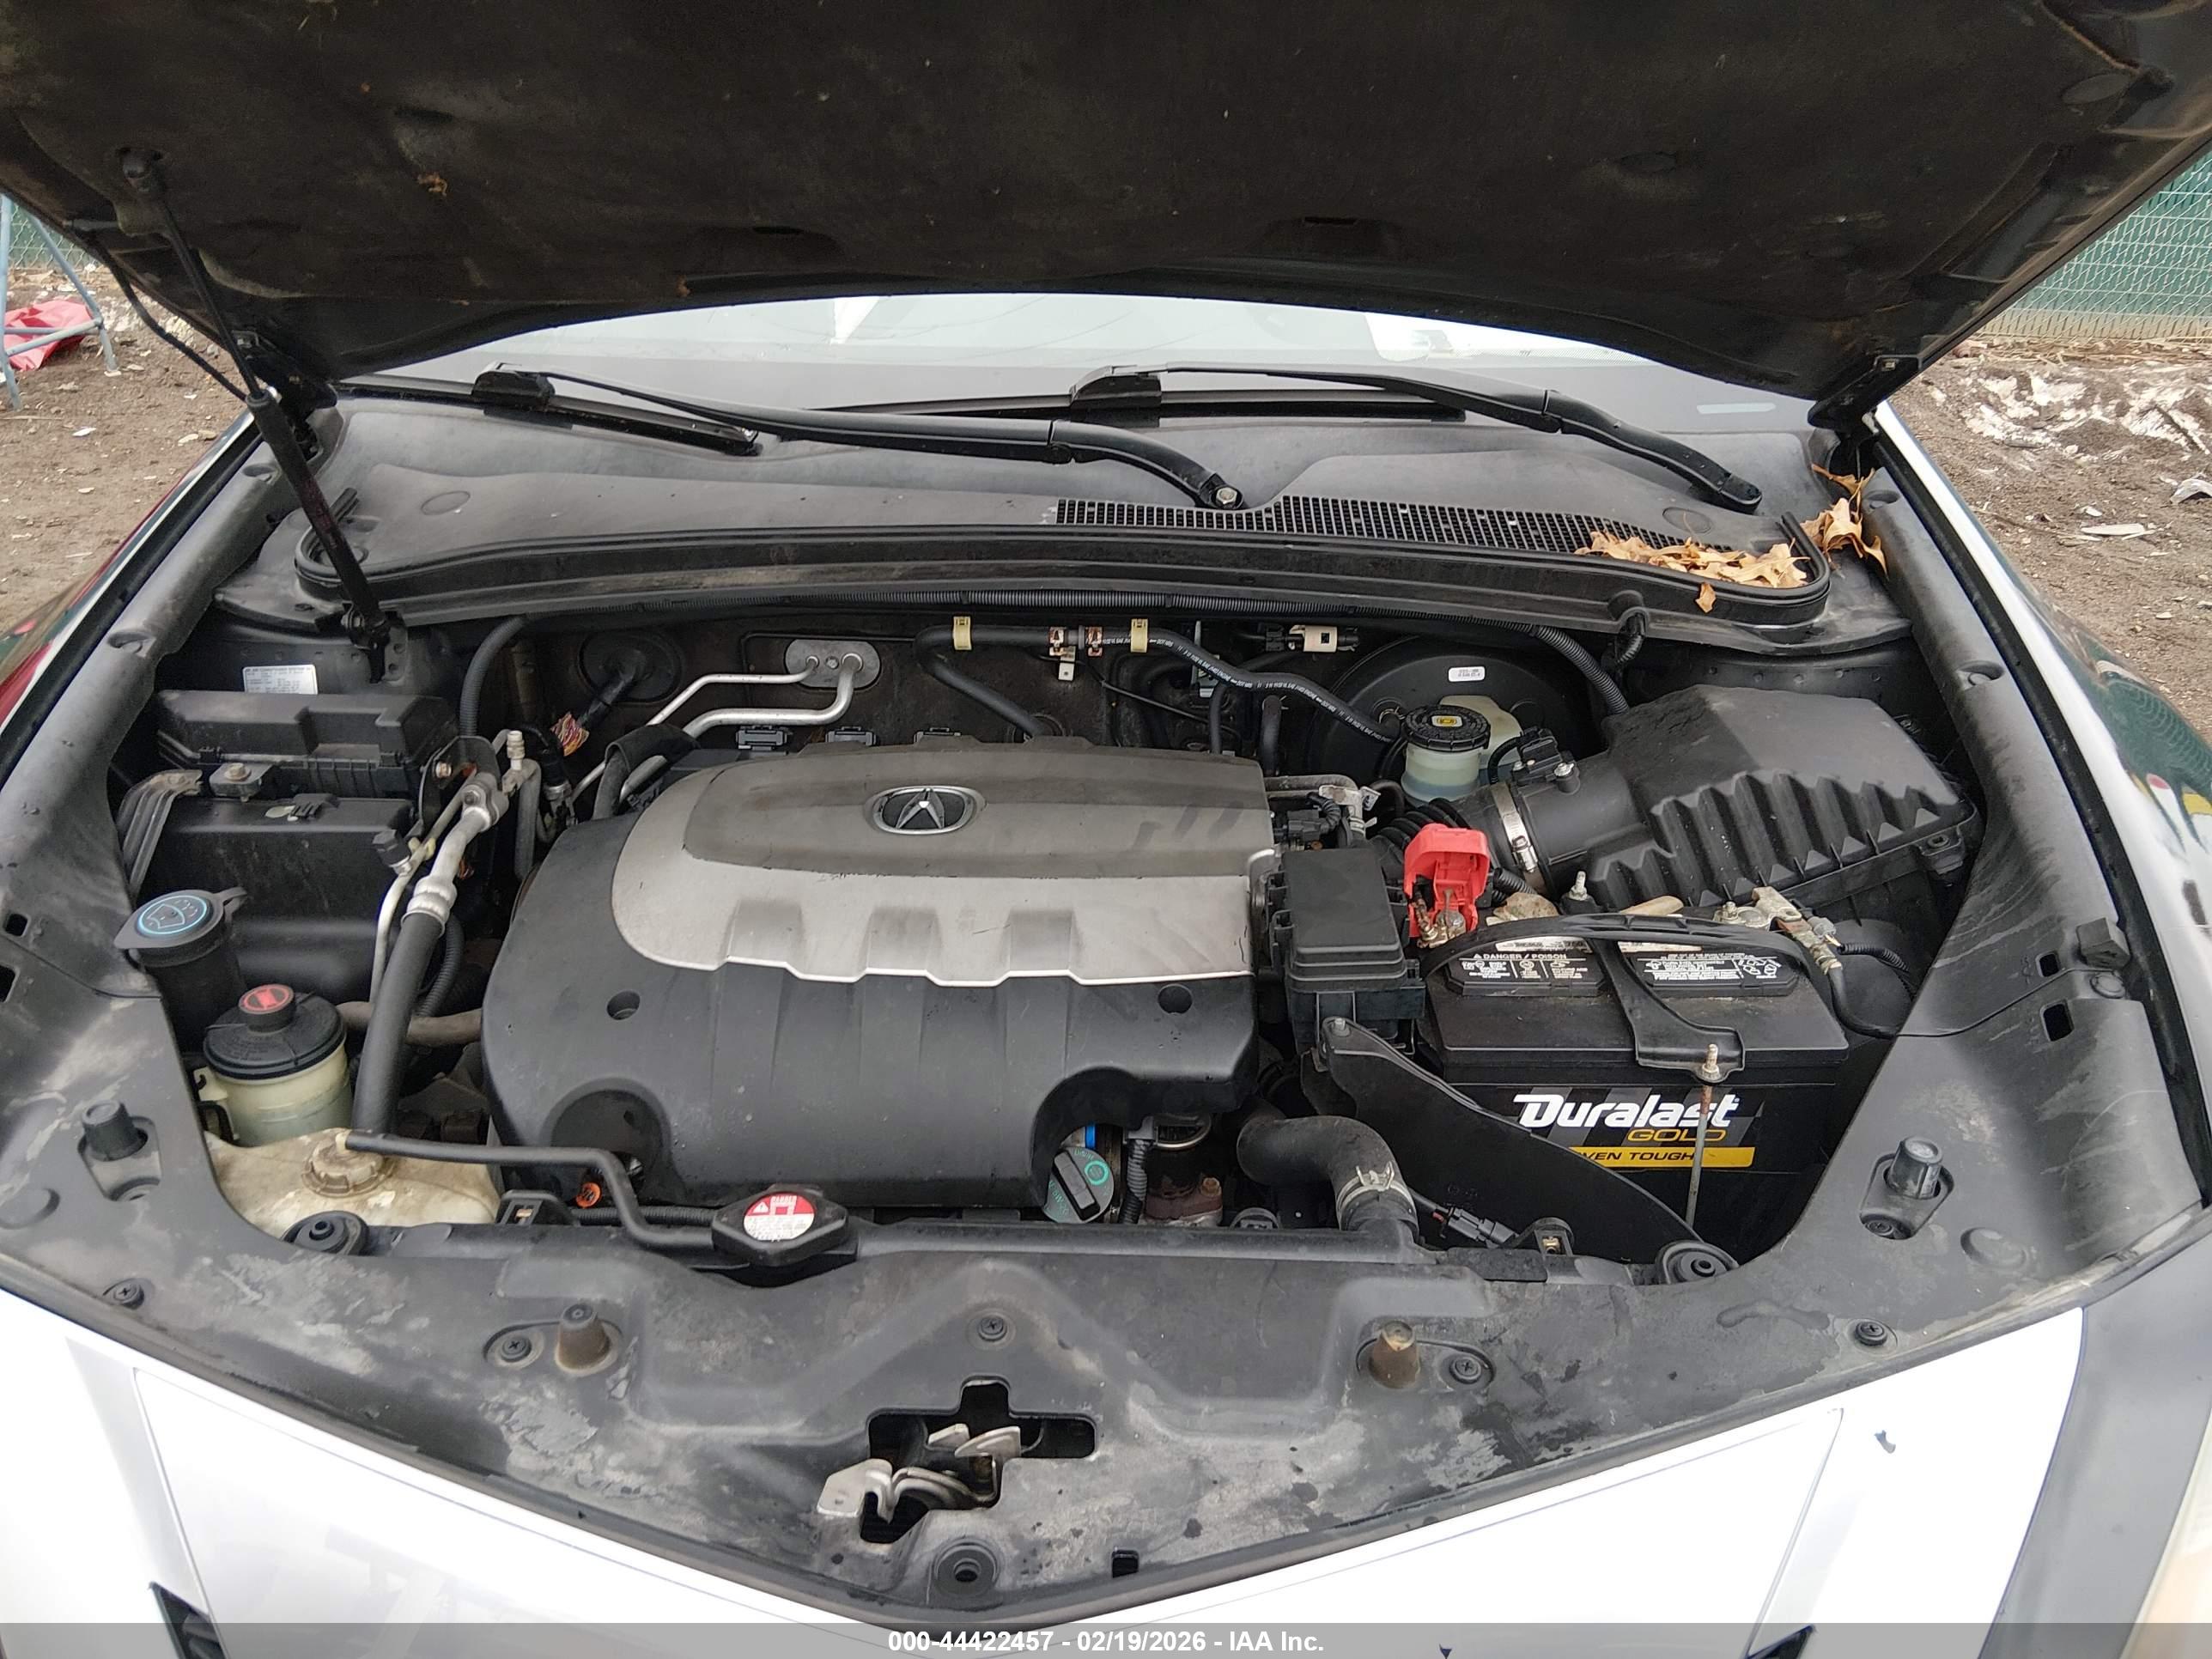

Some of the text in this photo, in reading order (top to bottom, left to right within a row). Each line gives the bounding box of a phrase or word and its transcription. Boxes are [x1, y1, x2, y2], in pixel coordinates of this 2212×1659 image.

[1513, 1094, 1739, 1127] Duralast
[1627, 1129, 1726, 1142] GOLD
[1628, 1152, 1694, 1161] TOUGH
